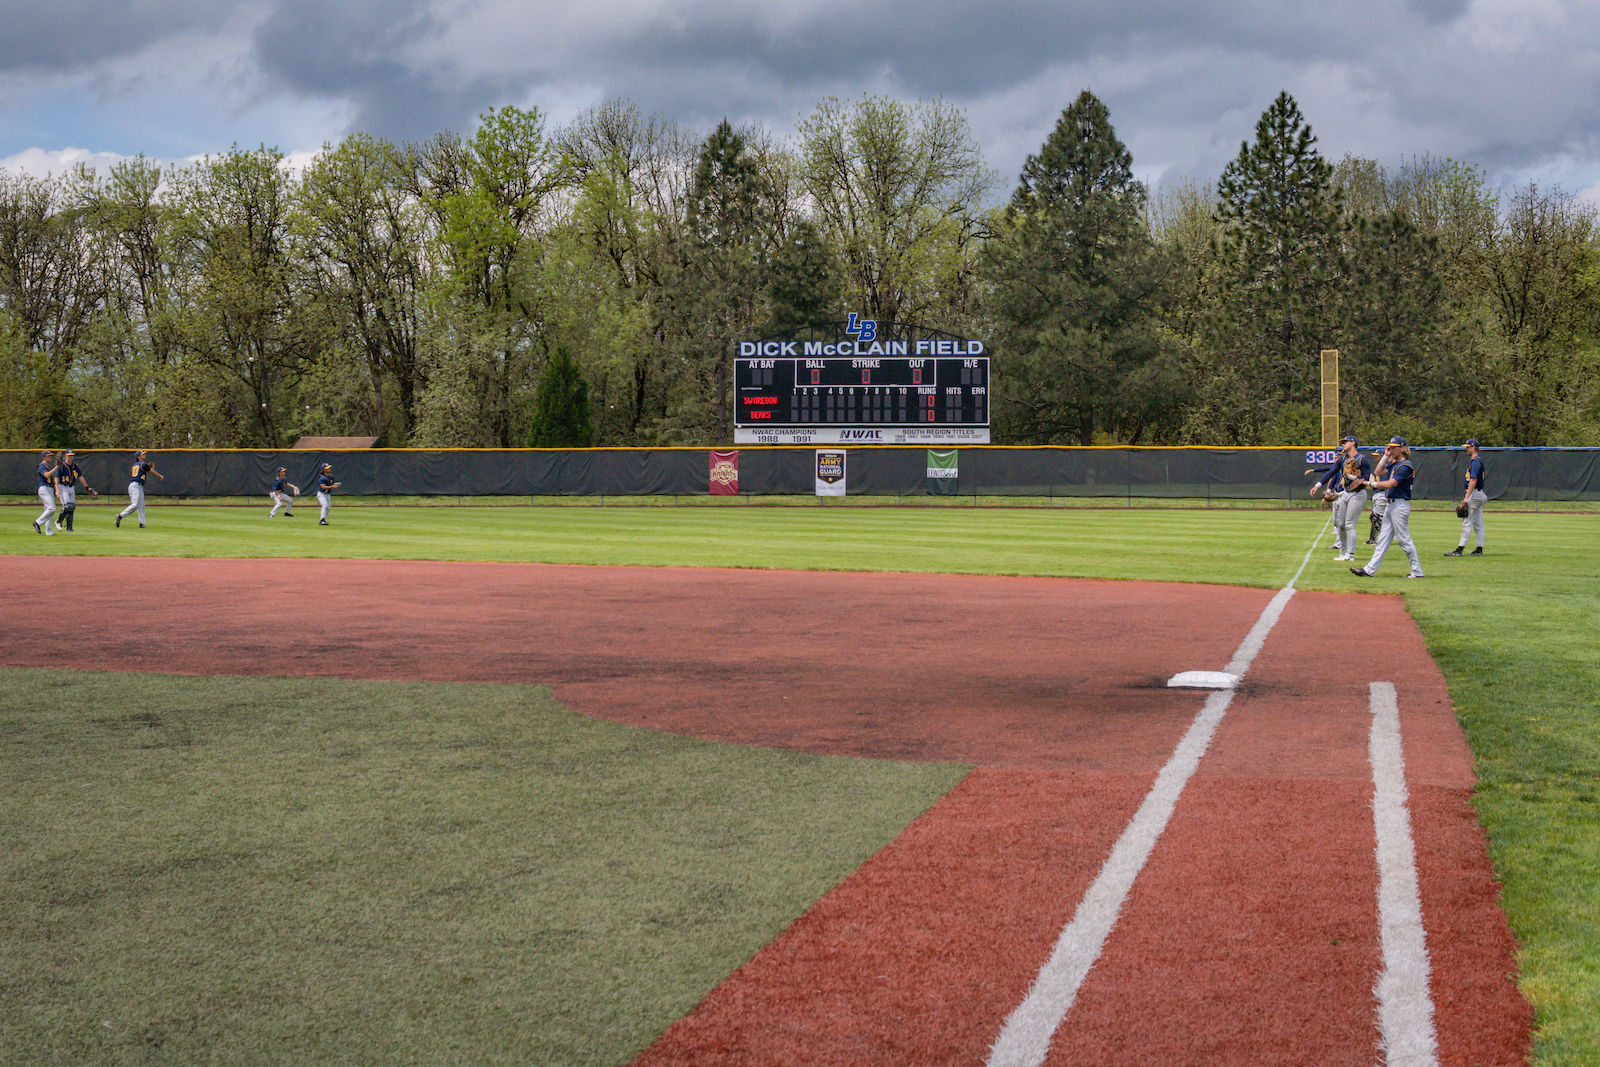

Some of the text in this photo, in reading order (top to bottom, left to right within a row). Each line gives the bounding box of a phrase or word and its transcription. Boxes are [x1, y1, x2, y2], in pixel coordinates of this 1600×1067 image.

[846, 312, 877, 342] LB
[740, 340, 985, 356] DICK McCLAIN FIELD
[748, 360, 775, 368] AT BAT
[805, 360, 825, 368] BALL
[852, 359, 880, 368] STRIKE
[909, 359, 925, 368] OUT
[964, 359, 978, 368] H/E
[811, 369, 820, 384] 0
[862, 369, 870, 384] 0
[913, 369, 921, 384] 0
[918, 387, 936, 395] RUNS
[946, 387, 961, 395] HITS
[972, 387, 985, 395] ERR
[928, 395, 935, 407] 0
[928, 409, 935, 421] 0
[840, 430, 882, 438] NWAC
[1306, 451, 1336, 463] 330
